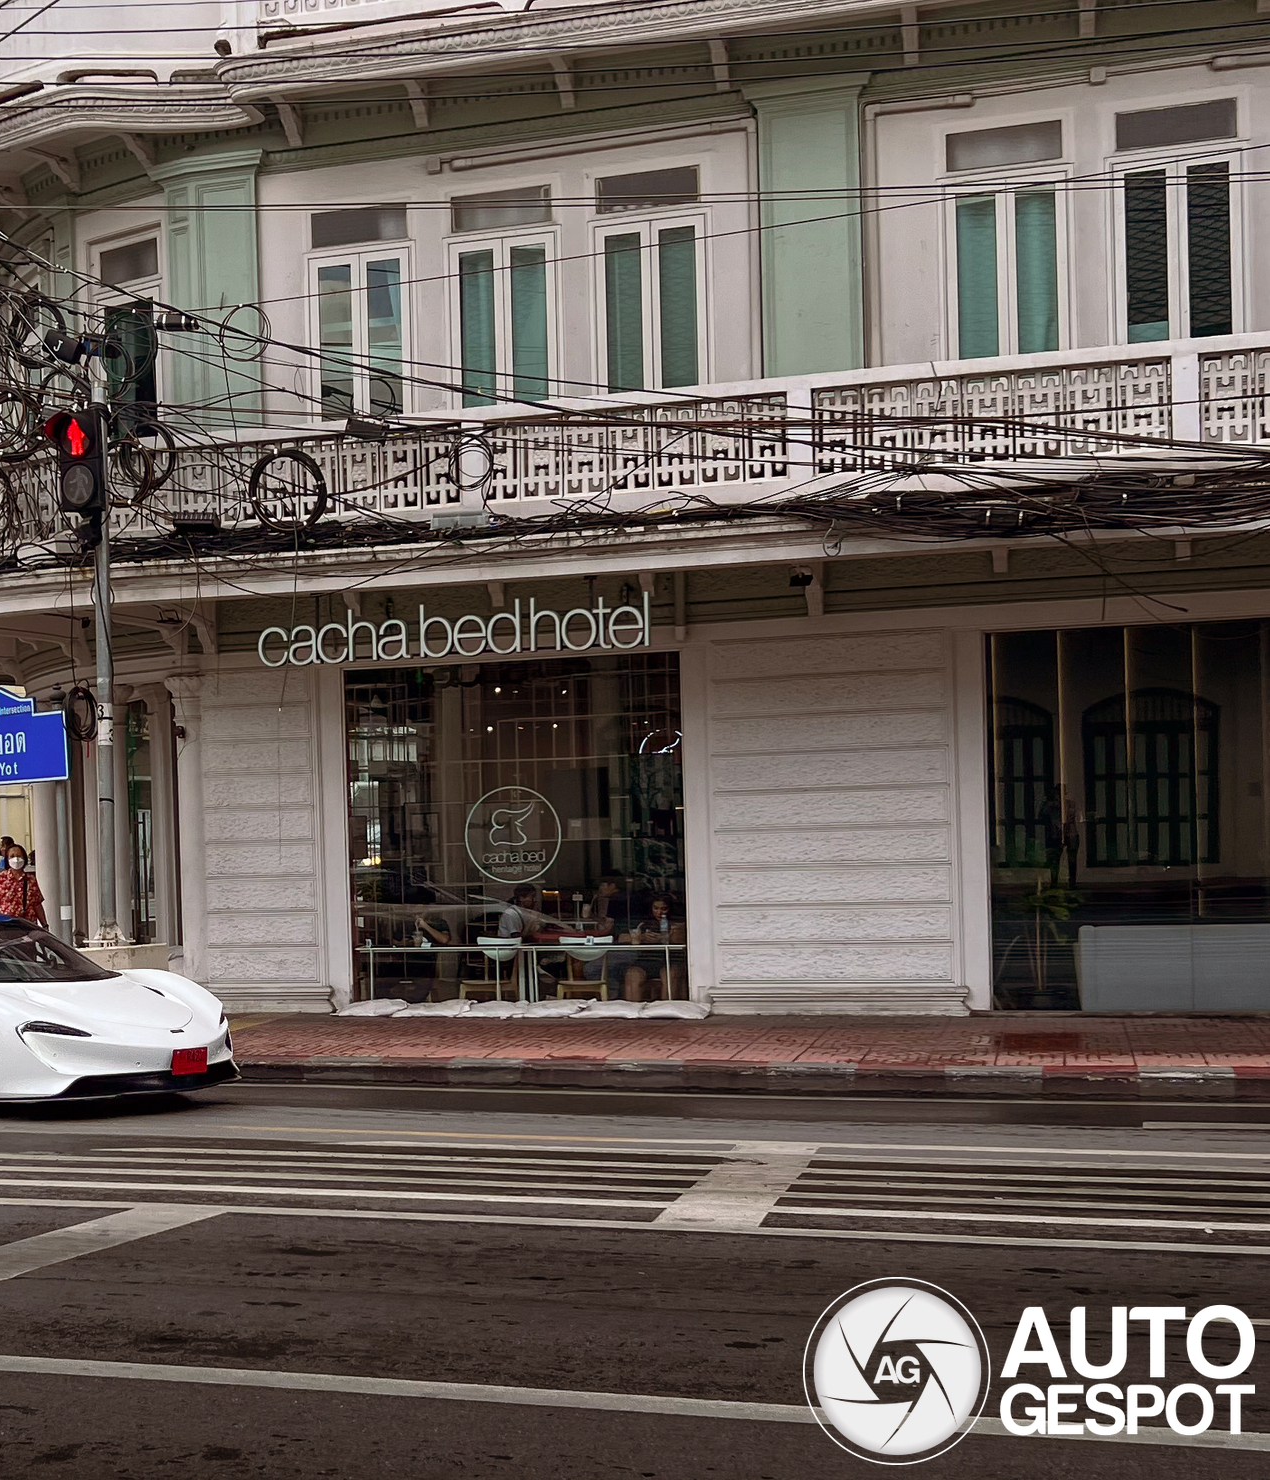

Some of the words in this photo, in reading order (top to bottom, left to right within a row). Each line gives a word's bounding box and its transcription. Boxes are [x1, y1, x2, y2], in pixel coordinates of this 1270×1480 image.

[258, 609, 412, 667] cacha
[419, 598, 522, 658] bed
[530, 591, 650, 652] hotel
[0, 704, 31, 716] Intersection
